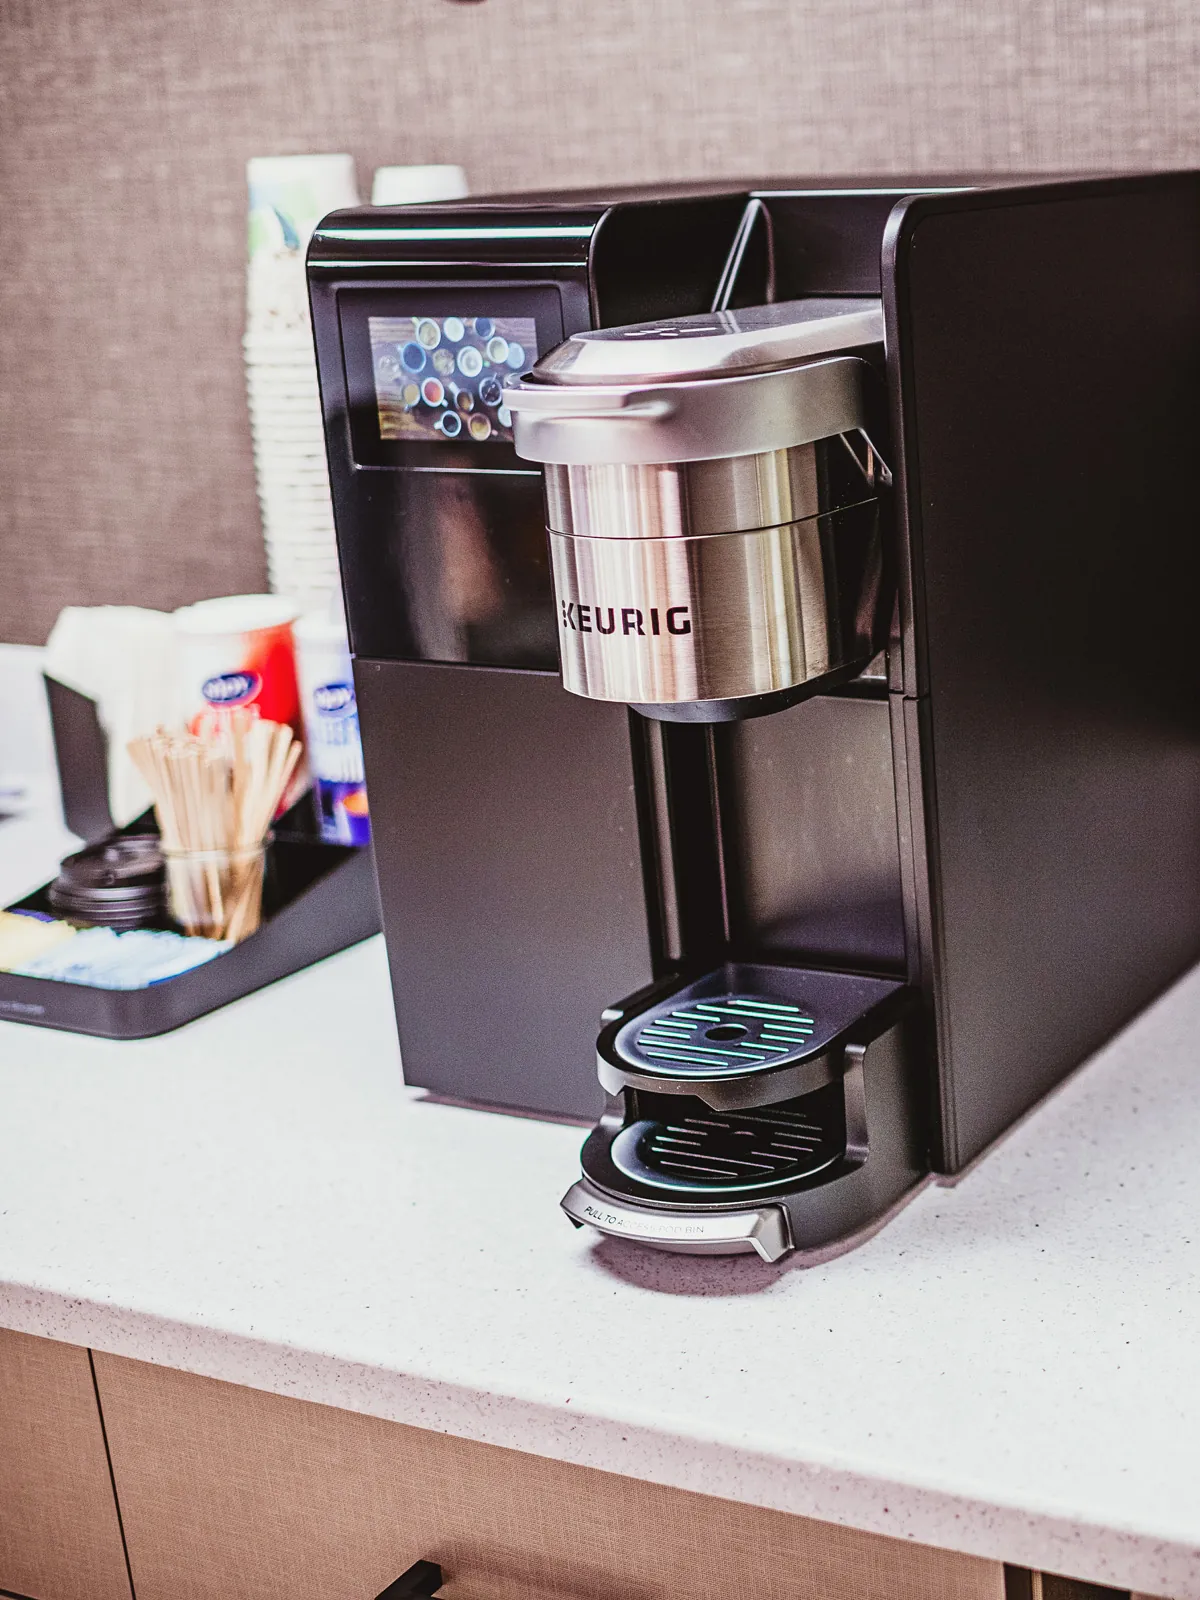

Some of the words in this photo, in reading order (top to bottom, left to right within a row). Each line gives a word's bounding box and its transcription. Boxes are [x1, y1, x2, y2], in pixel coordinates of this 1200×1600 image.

[562, 600, 692, 636] KEURIG
[583, 1205, 603, 1221] PULL
[604, 1214, 617, 1224] TO
[685, 1225, 704, 1234] BIN
